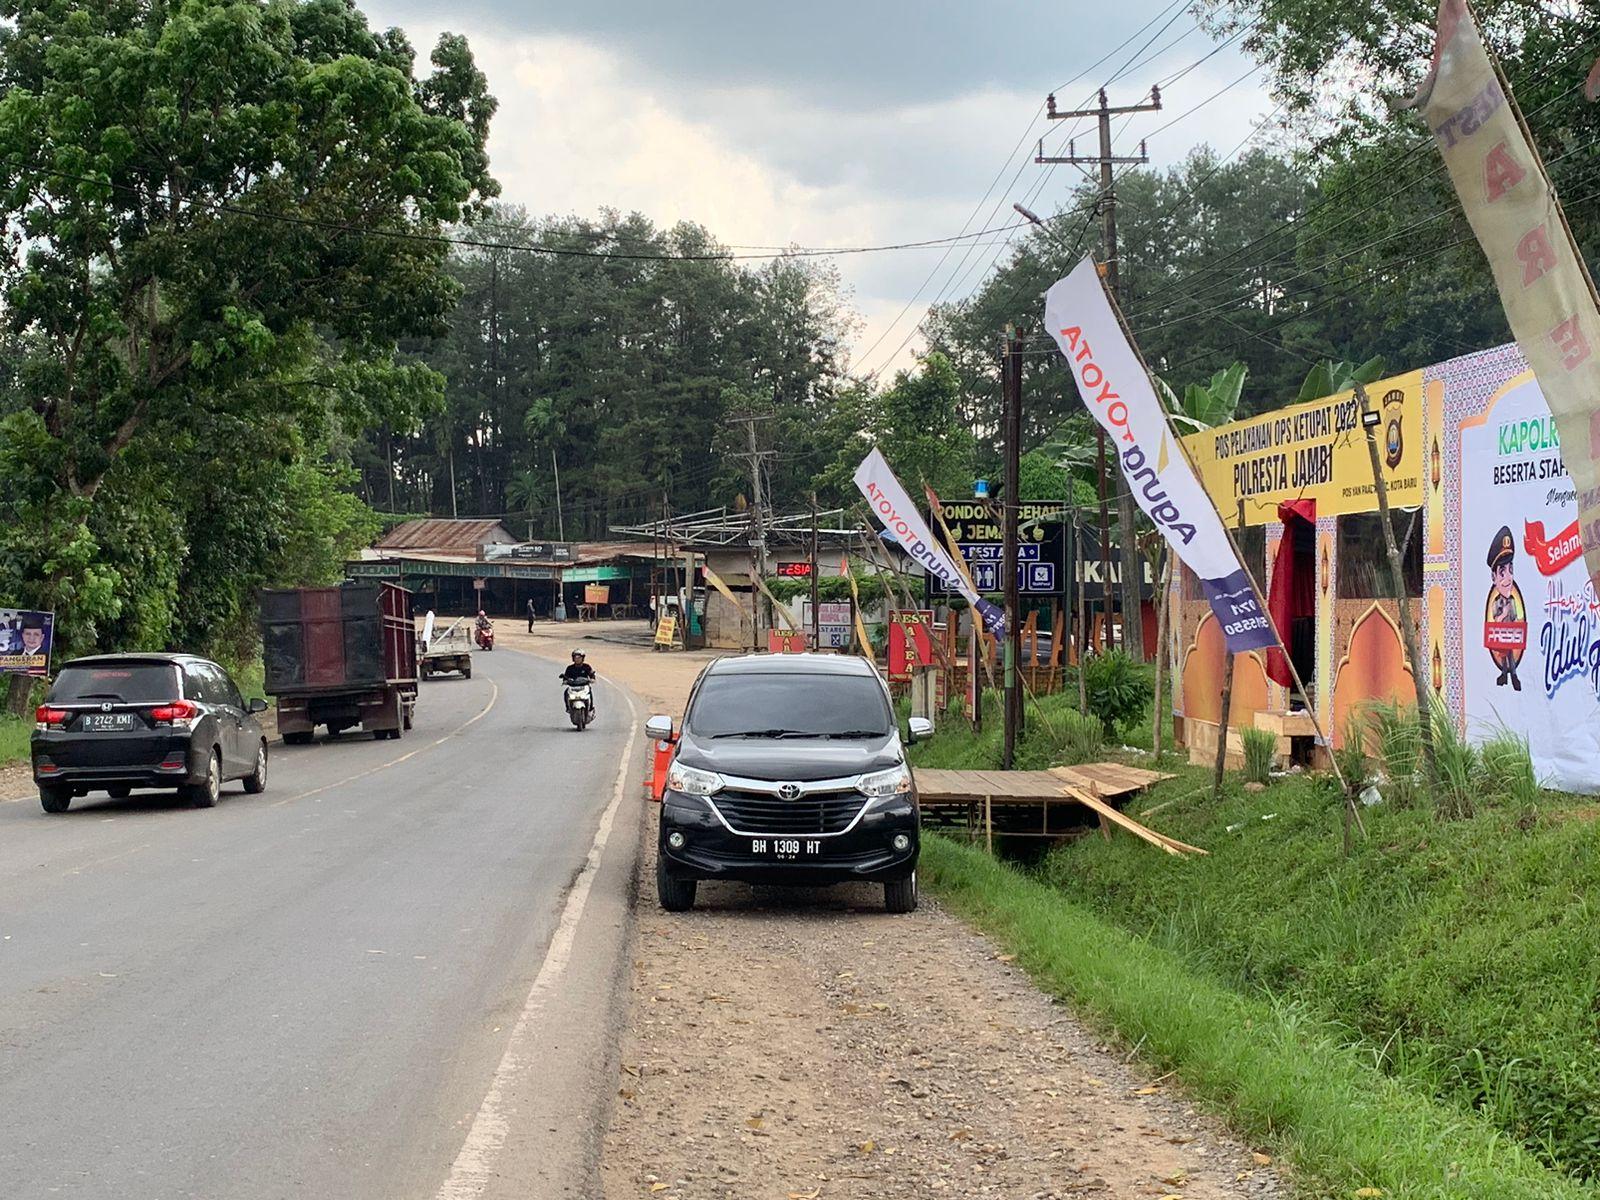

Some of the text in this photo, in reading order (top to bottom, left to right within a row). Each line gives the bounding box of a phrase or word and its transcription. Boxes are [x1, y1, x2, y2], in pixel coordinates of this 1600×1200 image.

[1215, 400, 1358, 460] POS PELAYANAN OPS KETUPAT 2023
[1234, 444, 1333, 497] POLRESTA JAMBI
[1494, 461, 1536, 484] BESERTA
[1390, 480, 1402, 491] KOTA
[1404, 478, 1417, 489] BARU
[1547, 534, 1581, 565] Selam
[1540, 615, 1585, 691] Idul
[85, 716, 91, 725] B
[752, 840, 821, 854] BH 1309 HT
